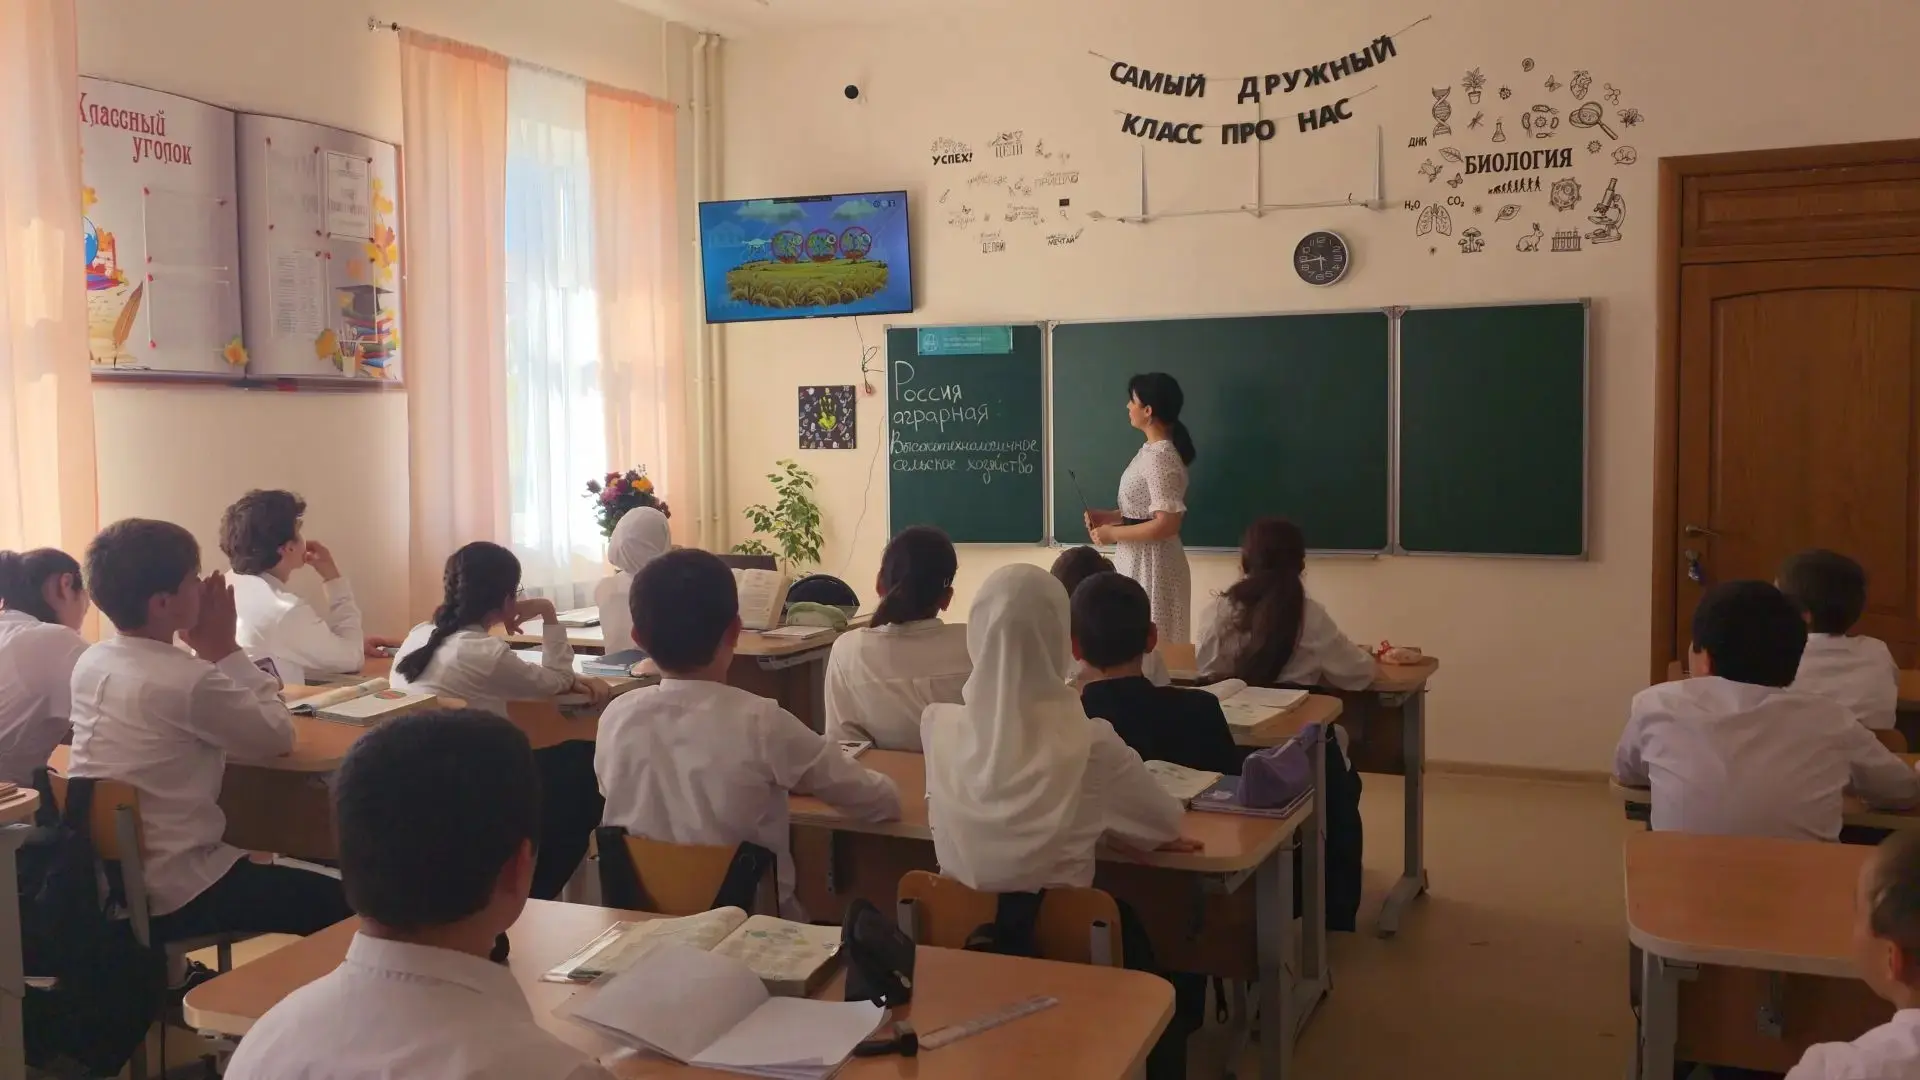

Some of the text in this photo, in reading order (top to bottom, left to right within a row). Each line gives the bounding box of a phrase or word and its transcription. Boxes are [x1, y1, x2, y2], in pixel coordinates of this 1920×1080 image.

[1110, 34, 1398, 104] САМЫЙ ДРУЖНЫЙ
[1121, 97, 1353, 145] КЛАСС ПРО НАС
[132, 136, 192, 165] уголок
[1408, 136, 1428, 148] ДНК
[932, 152, 973, 166] УСПЕХ!
[1465, 148, 1573, 175] БИОЛОГИЯ
[894, 360, 963, 404] Россия
[893, 403, 989, 432] аграрная
[892, 452, 1034, 484] сельское хозяйство
